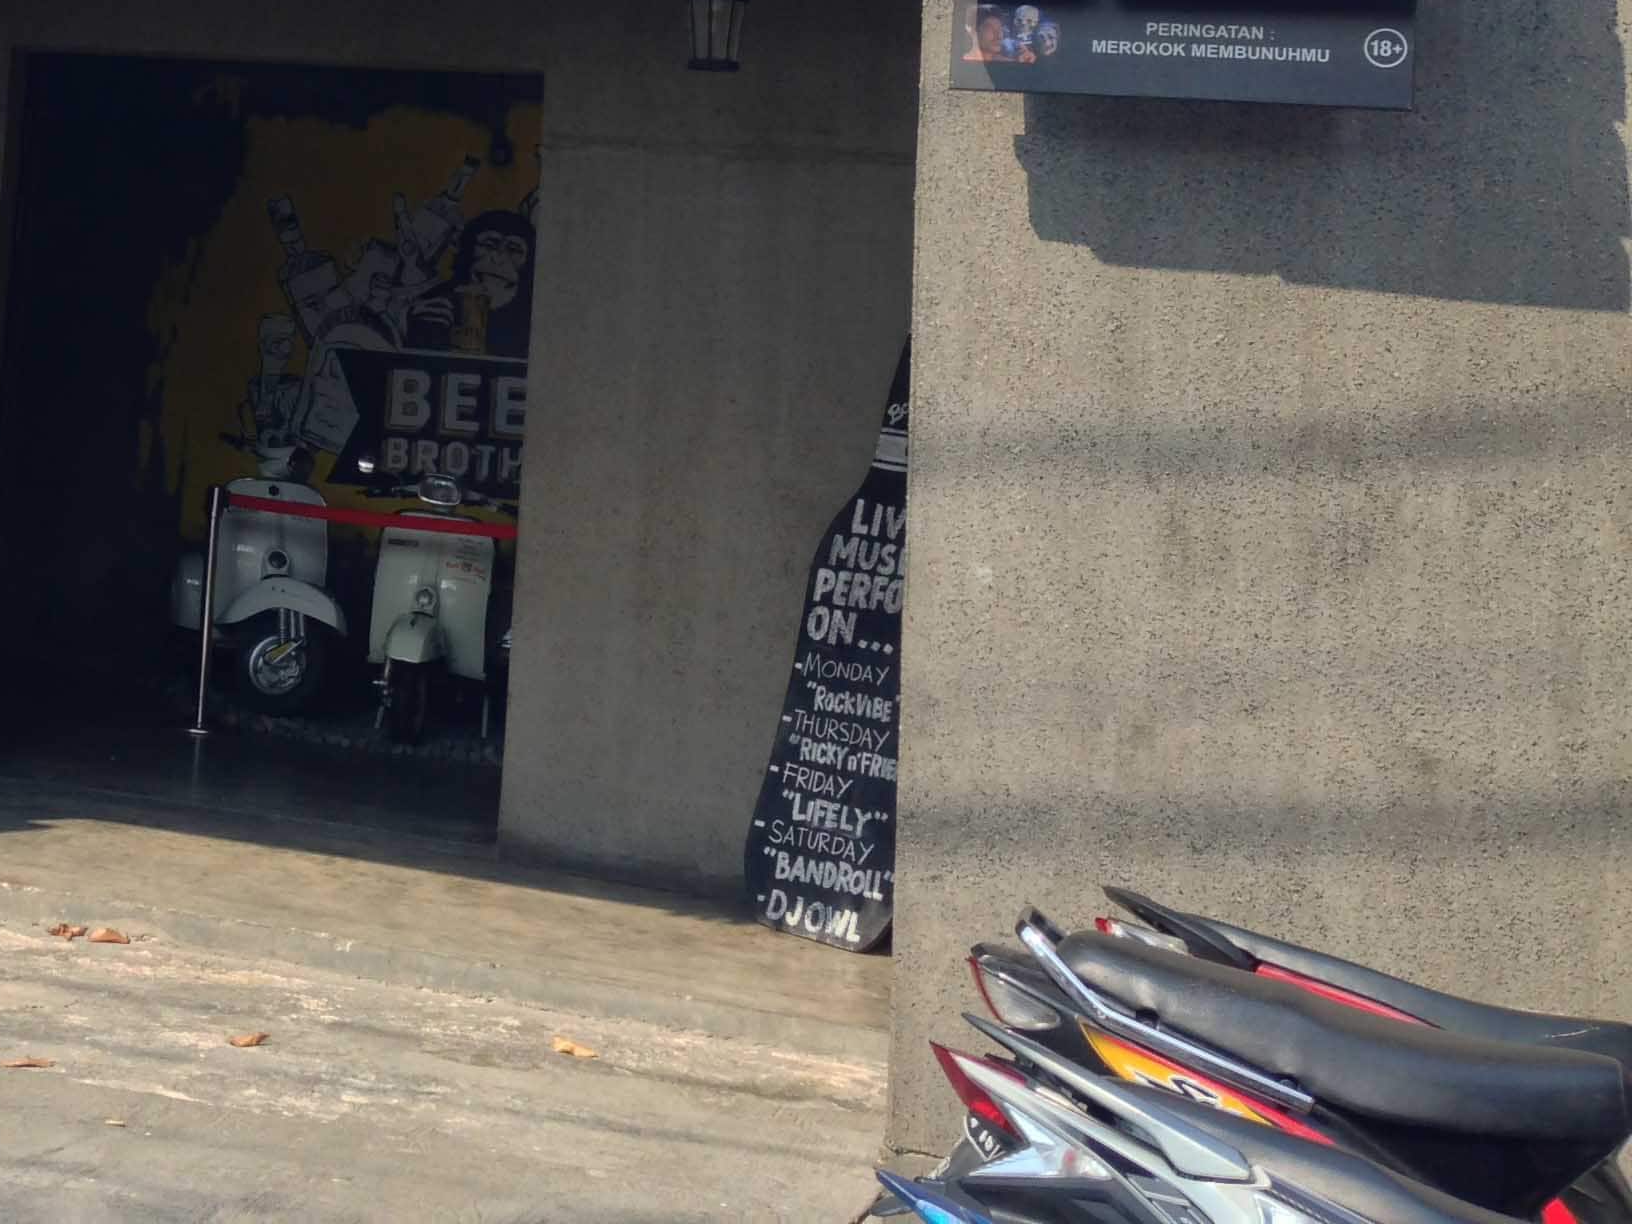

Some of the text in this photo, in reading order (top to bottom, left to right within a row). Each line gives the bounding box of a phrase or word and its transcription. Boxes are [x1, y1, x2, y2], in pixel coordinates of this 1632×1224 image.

[1145, 22, 1264, 41] PERINGATAN
[1091, 39, 1330, 63] MEROKOK MEMBUNUHMU
[1369, 38, 1403, 57] 18+
[386, 369, 527, 437] BEE
[813, 567, 903, 615] PERFO
